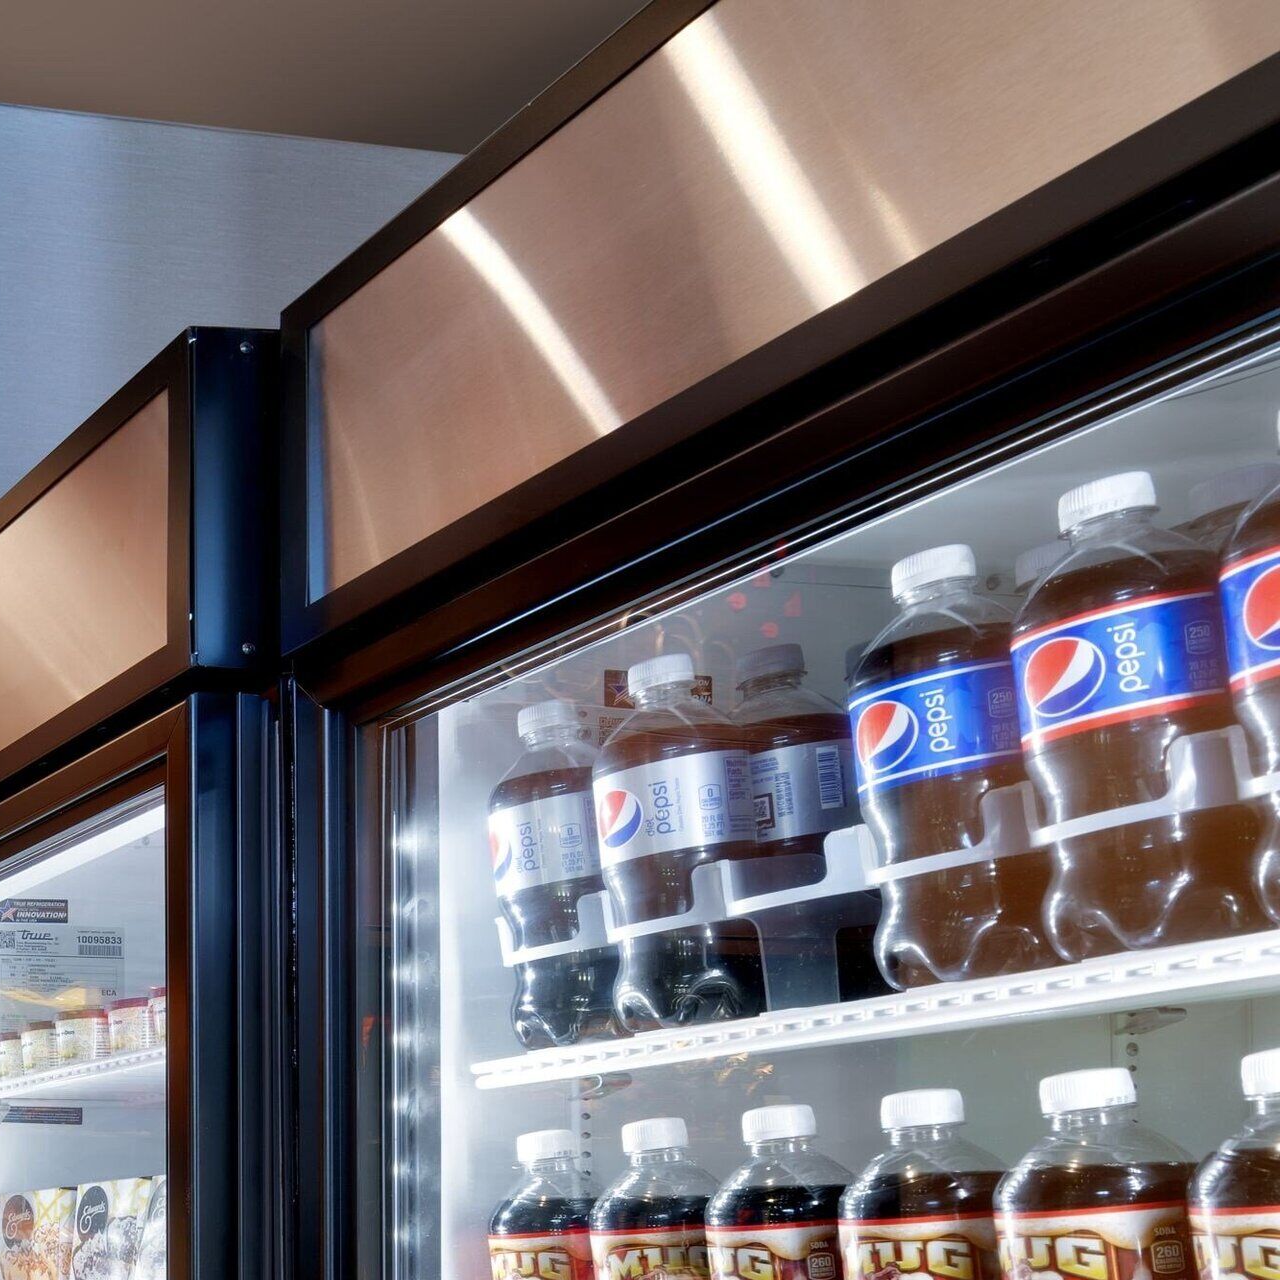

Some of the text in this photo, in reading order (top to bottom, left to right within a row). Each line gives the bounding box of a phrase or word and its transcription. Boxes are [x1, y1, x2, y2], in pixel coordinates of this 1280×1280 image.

[1189, 624, 1211, 638] 250
[1106, 620, 1145, 693] pepsi
[992, 690, 1013, 704] 250
[919, 688, 956, 753] pepsi
[655, 780, 675, 836] pepsi
[524, 822, 540, 872] pepsi
[76, 935, 122, 945] 10095833
[101, 989, 117, 997] ECA
[1153, 1226, 1176, 1236] SODA
[810, 1240, 829, 1250] SODA
[1156, 1244, 1180, 1258] 260
[811, 1257, 832, 1268] 260
